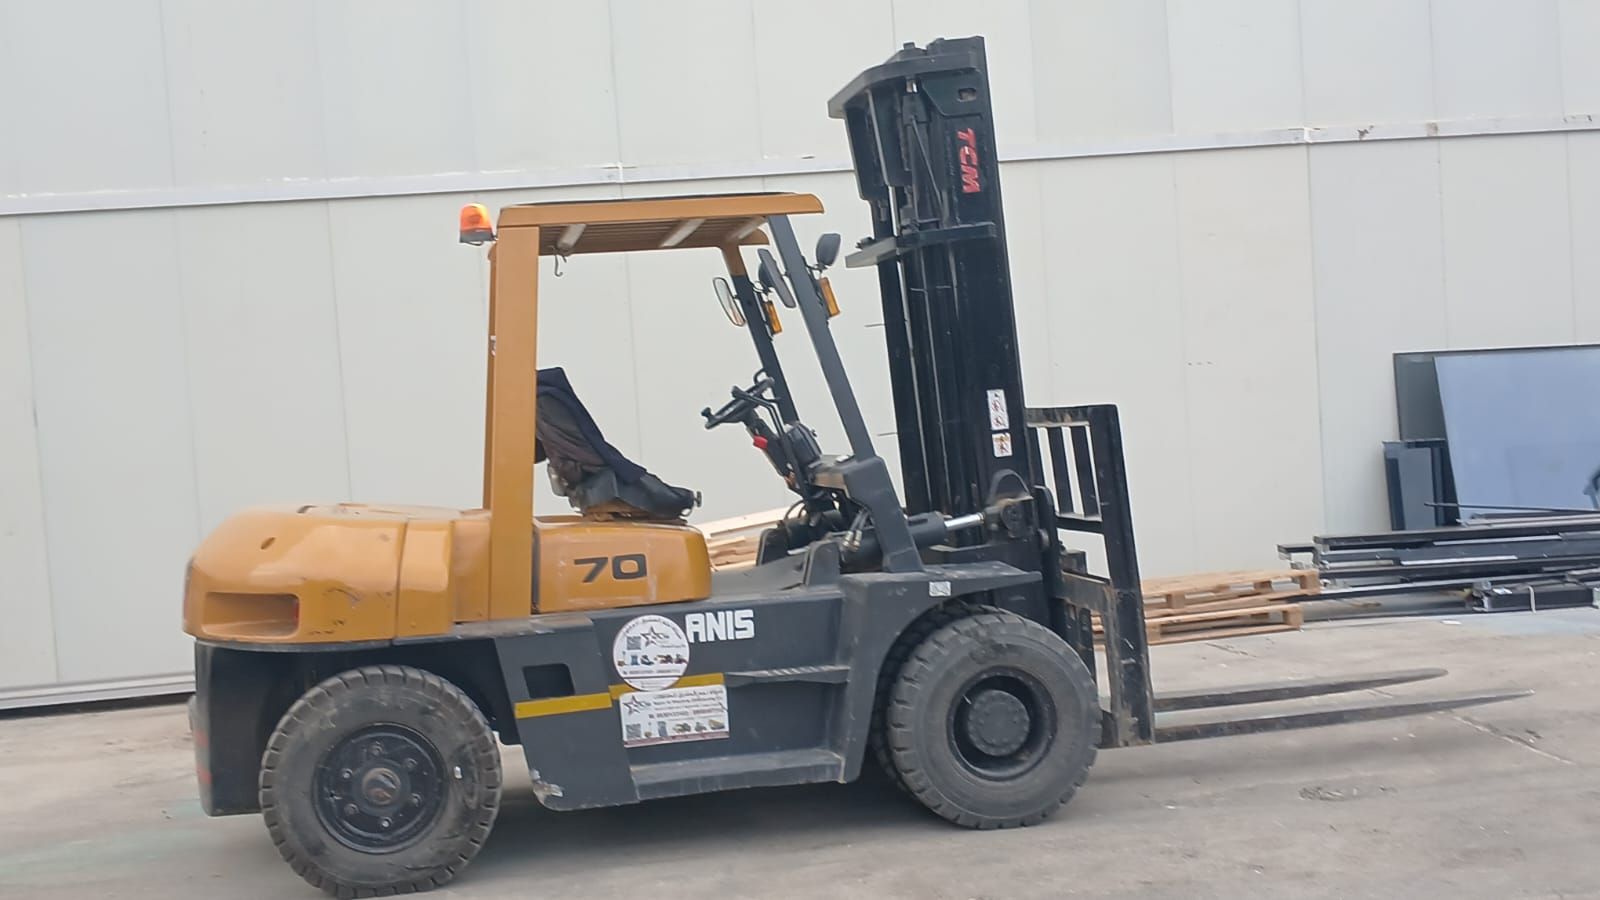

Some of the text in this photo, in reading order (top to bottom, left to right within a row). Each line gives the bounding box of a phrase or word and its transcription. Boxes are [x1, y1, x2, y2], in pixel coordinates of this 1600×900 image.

[957, 127, 981, 193] TCM
[574, 553, 647, 583] 70
[685, 609, 754, 643] ANIS
